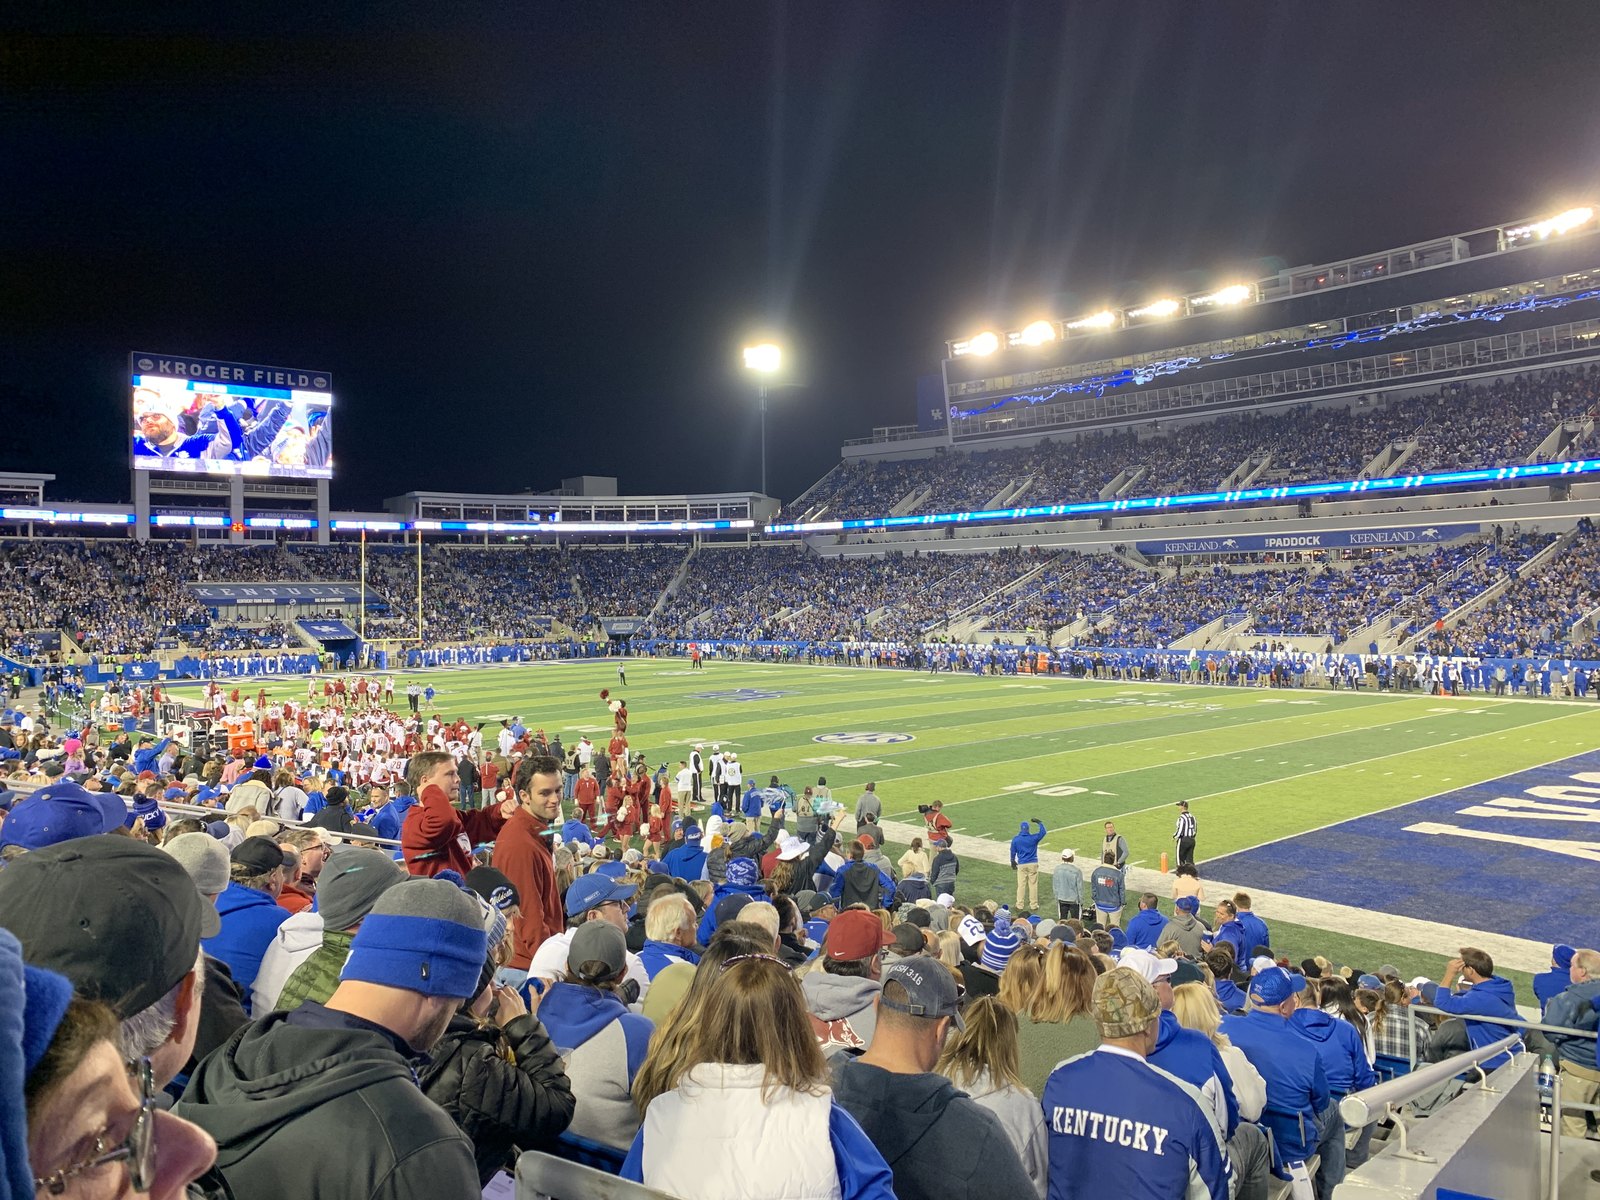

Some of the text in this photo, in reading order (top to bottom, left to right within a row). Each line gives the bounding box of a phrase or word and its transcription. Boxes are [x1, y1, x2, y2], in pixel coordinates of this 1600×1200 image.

[159, 359, 245, 381] KROGER
[254, 369, 309, 387] FIELD
[232, 523, 243, 532] 25
[1269, 535, 1321, 548] PADDOCK
[1350, 530, 1415, 544] KEENELAND
[1165, 541, 1219, 552] KEENELAND
[198, 586, 363, 596] KENTUCKY
[906, 968, 923, 986] 3:16
[1053, 1106, 1168, 1156] KENTUCKY
